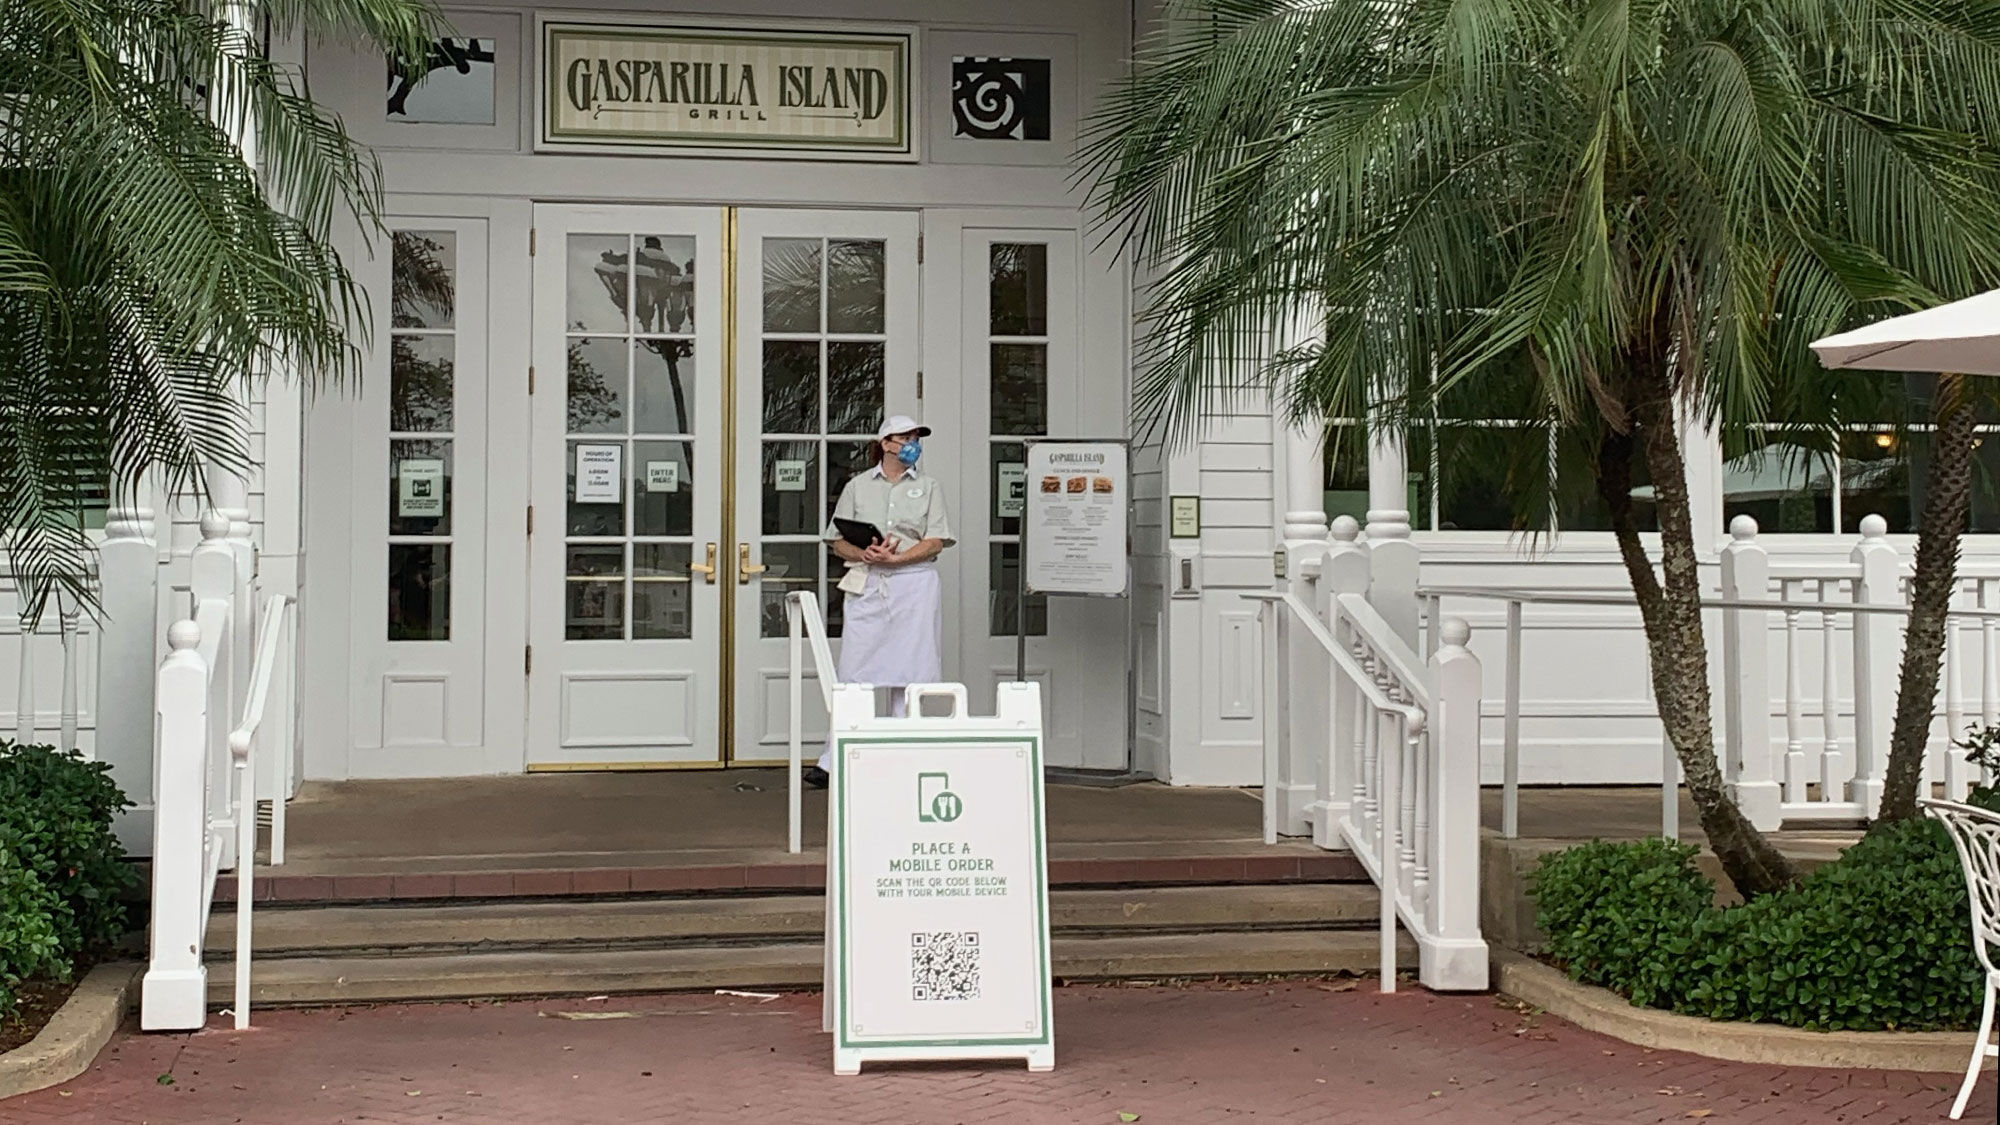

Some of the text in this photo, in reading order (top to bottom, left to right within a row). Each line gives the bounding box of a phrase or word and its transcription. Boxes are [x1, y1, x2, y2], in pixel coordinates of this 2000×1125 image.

[567, 58, 888, 119] GASPARILLA ISLAND
[689, 109, 767, 120] GRILL
[912, 842, 971, 855] PLACE A
[889, 858, 994, 872] MOBILE ORDER
[876, 877, 1007, 887] SCAN THE QR CODE BELOW
[877, 887, 1007, 898] WITH YOUR MOBILE DEVICE
